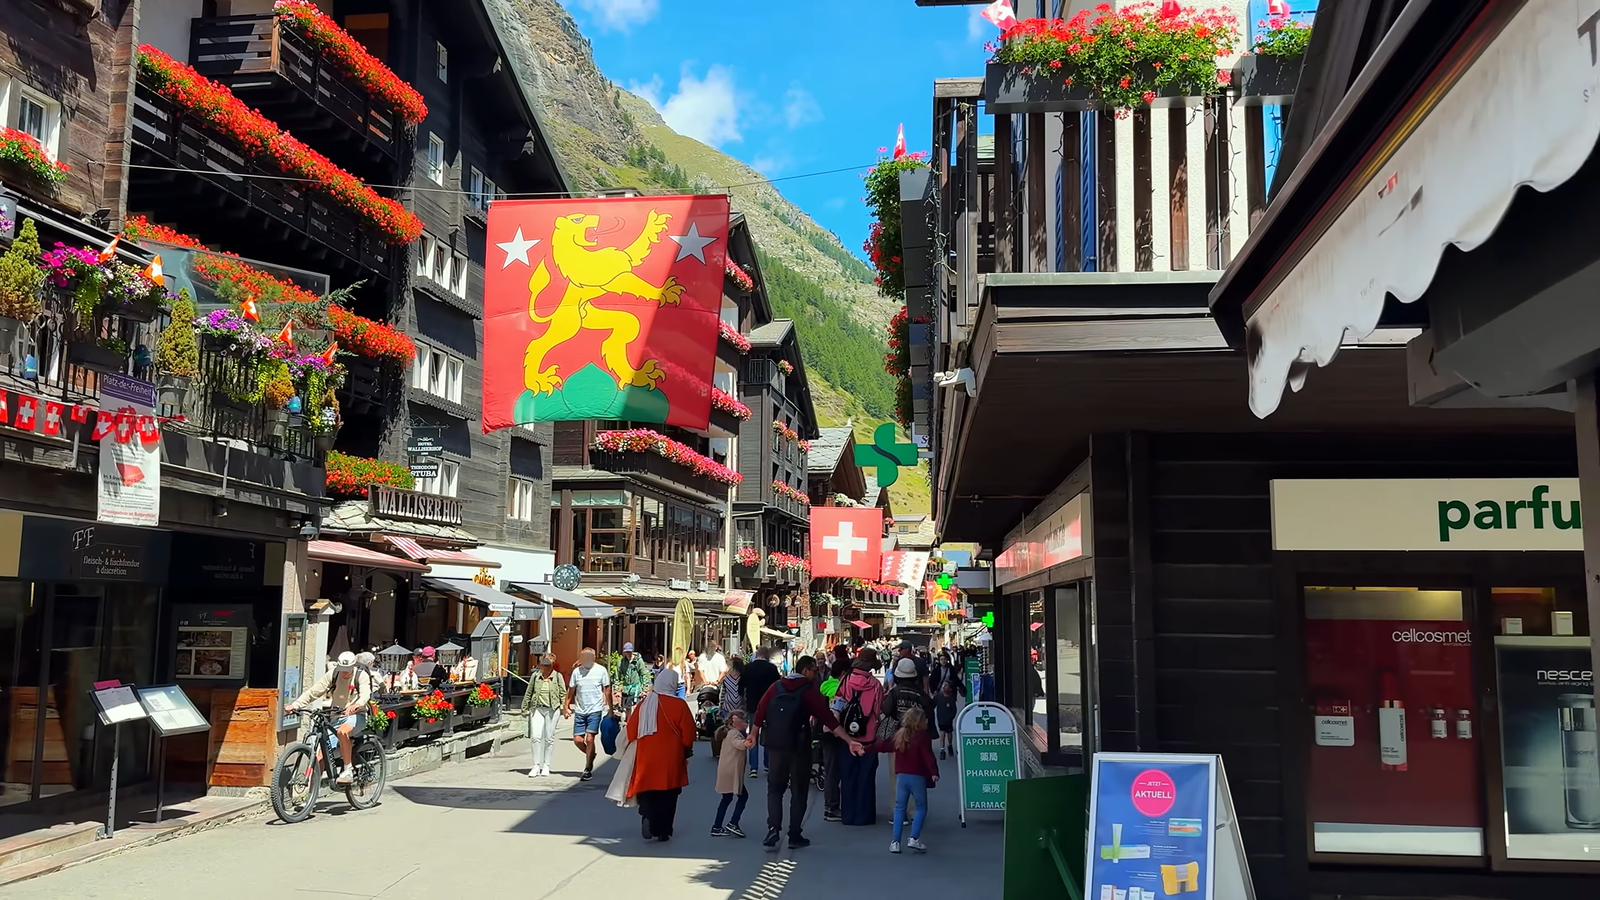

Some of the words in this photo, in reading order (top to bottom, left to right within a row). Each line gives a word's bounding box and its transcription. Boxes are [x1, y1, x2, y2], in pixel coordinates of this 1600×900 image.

[103, 374, 152, 396] Platz-der-Freiheit
[376, 488, 462, 524] WALLISERHOF
[1438, 485, 1582, 542] parfu
[72, 527, 95, 550] FF
[105, 557, 109, 566] &
[110, 557, 140, 568] fischfondue
[1392, 628, 1472, 643] cellcosmet
[966, 738, 1010, 746] APOTHEKE
[967, 769, 1014, 777] PHARMACY
[1135, 790, 1172, 799] AKTUELL
